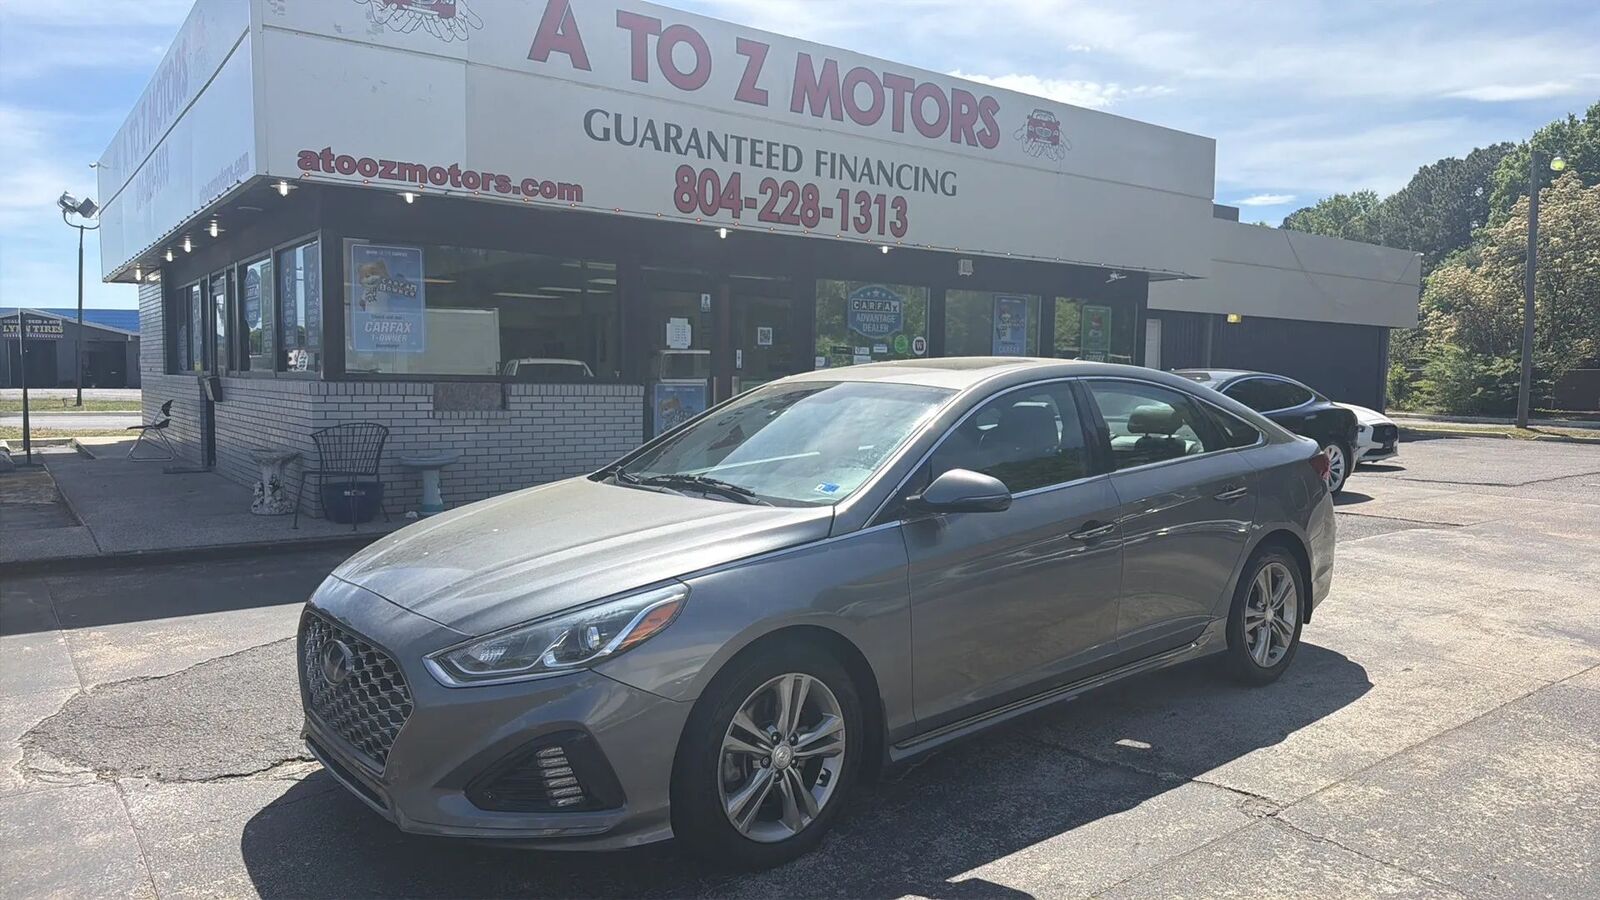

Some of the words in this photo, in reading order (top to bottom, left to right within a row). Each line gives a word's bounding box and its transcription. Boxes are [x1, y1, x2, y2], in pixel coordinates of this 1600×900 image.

[527, 0, 592, 72] A
[616, 9, 712, 91] TO
[734, 36, 770, 107] Z
[789, 51, 1001, 150] MOTORS
[583, 108, 803, 173] GUARANTEED
[815, 150, 958, 197] FINANCING
[297, 147, 584, 202] atoozmotors.com
[674, 164, 908, 238] 804-228-1313
[853, 301, 899, 312] CARFAX
[856, 313, 897, 323] ADVANTAGE
[32, 325, 63, 333] TIRES
[365, 321, 412, 333] CARFAX
[862, 323, 889, 333] DEALER
